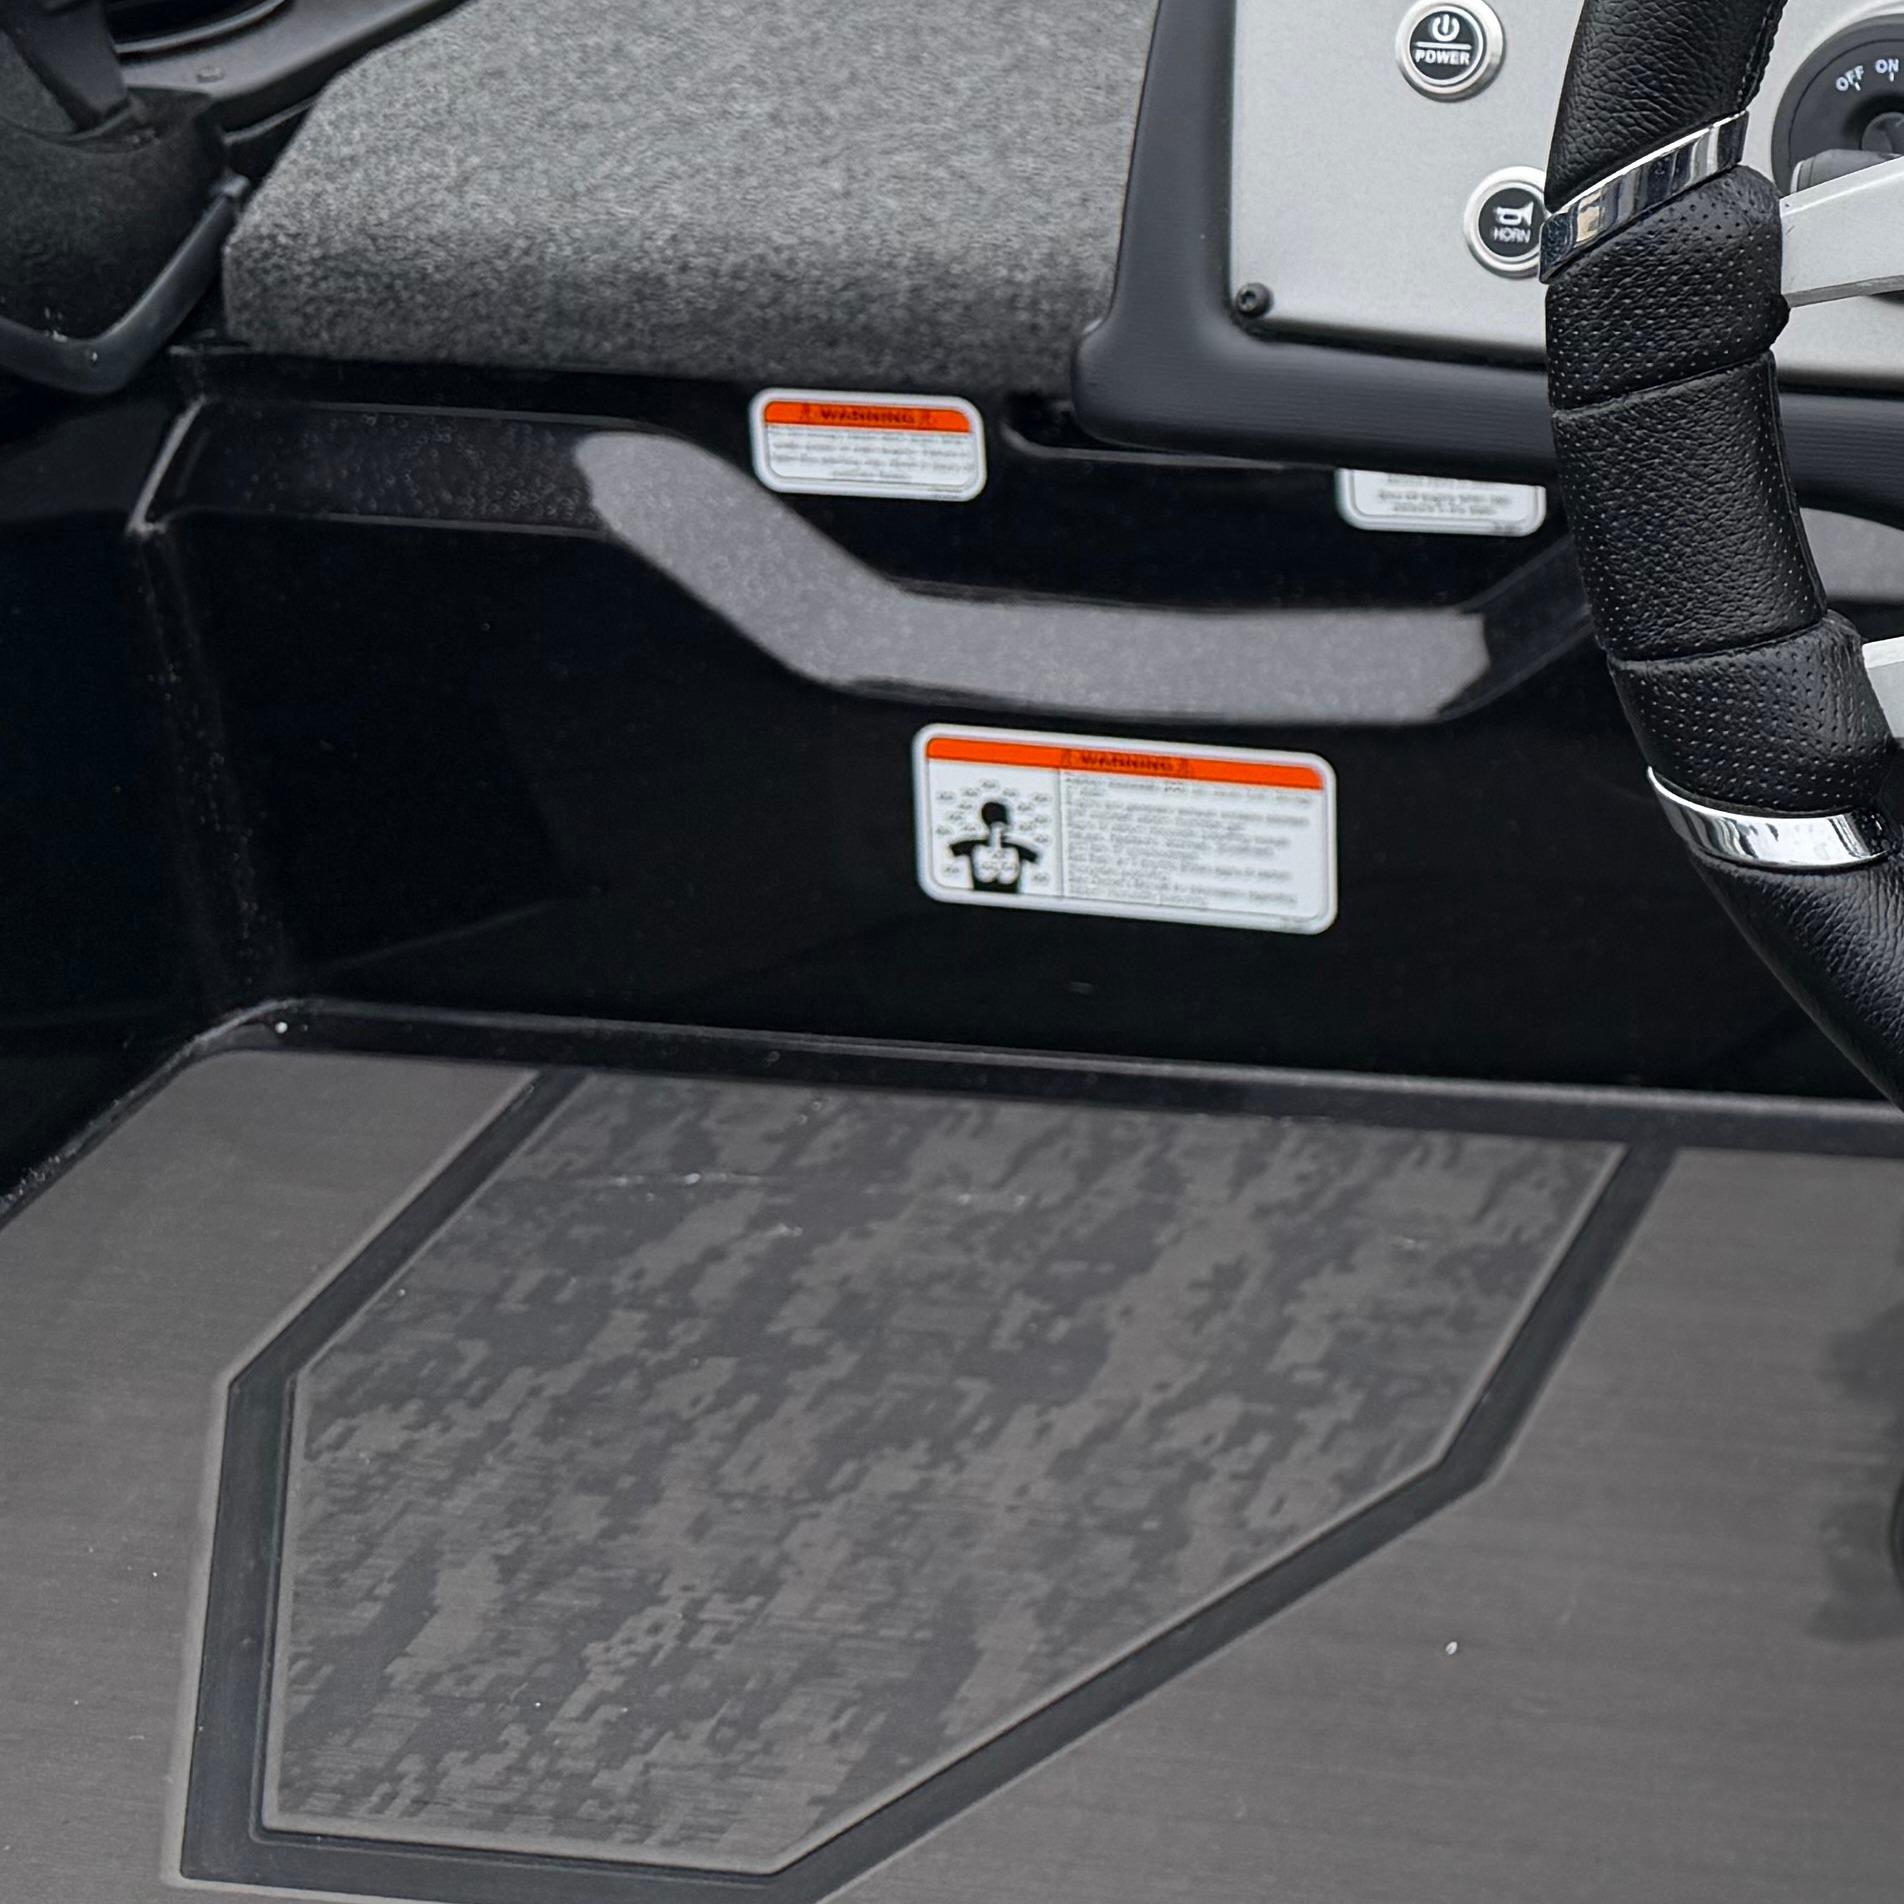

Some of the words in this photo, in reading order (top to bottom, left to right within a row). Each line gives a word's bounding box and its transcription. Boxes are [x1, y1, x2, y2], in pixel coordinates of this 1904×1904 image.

[1414, 48, 1471, 66] POWER
[1835, 65, 1865, 92] OFF
[1874, 58, 1901, 74] ON
[1493, 226, 1531, 244] HORN
